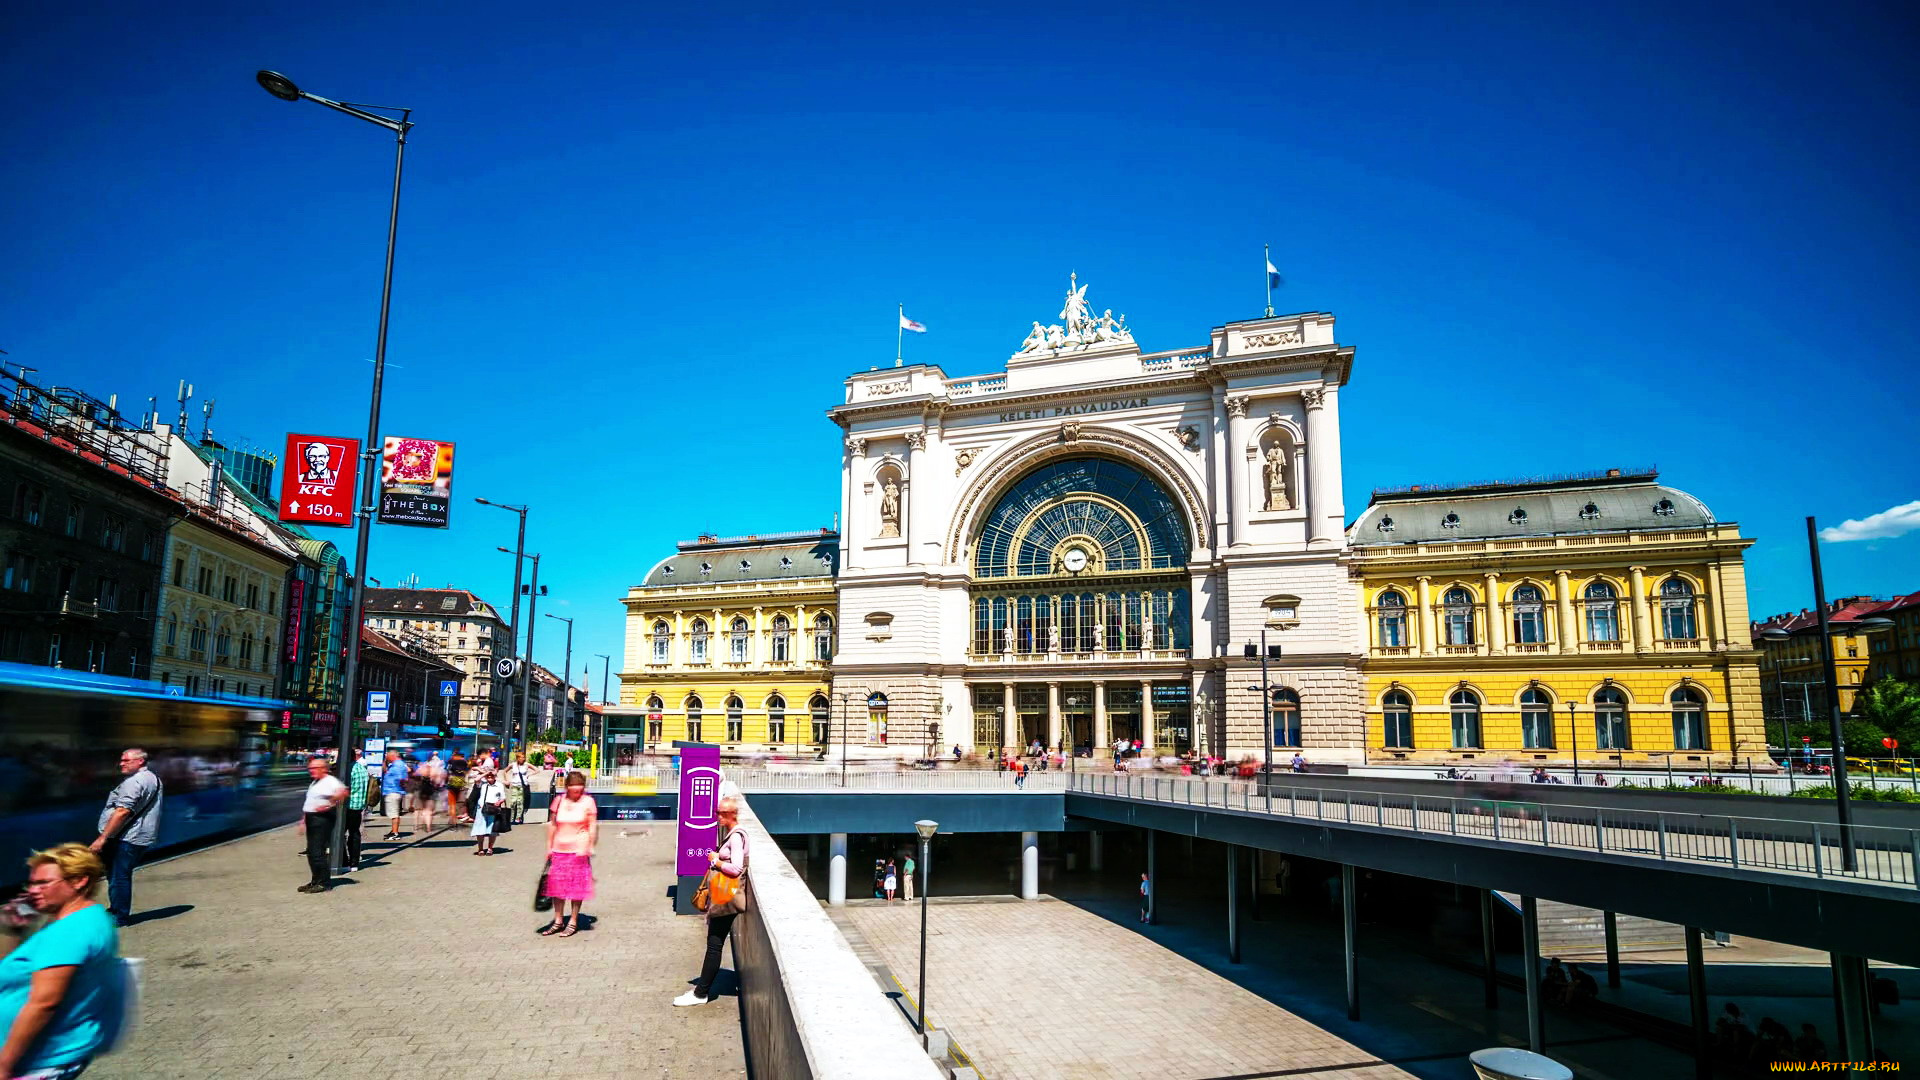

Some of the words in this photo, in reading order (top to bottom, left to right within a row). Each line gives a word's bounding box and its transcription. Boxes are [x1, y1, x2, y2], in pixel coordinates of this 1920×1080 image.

[1000, 410, 1045, 423] KELETI
[298, 484, 336, 496] KFC
[307, 503, 333, 516] 150
[391, 500, 415, 509] THE
[422, 502, 446, 512] BOX
[381, 514, 445, 523] www.theboxdonut.com
